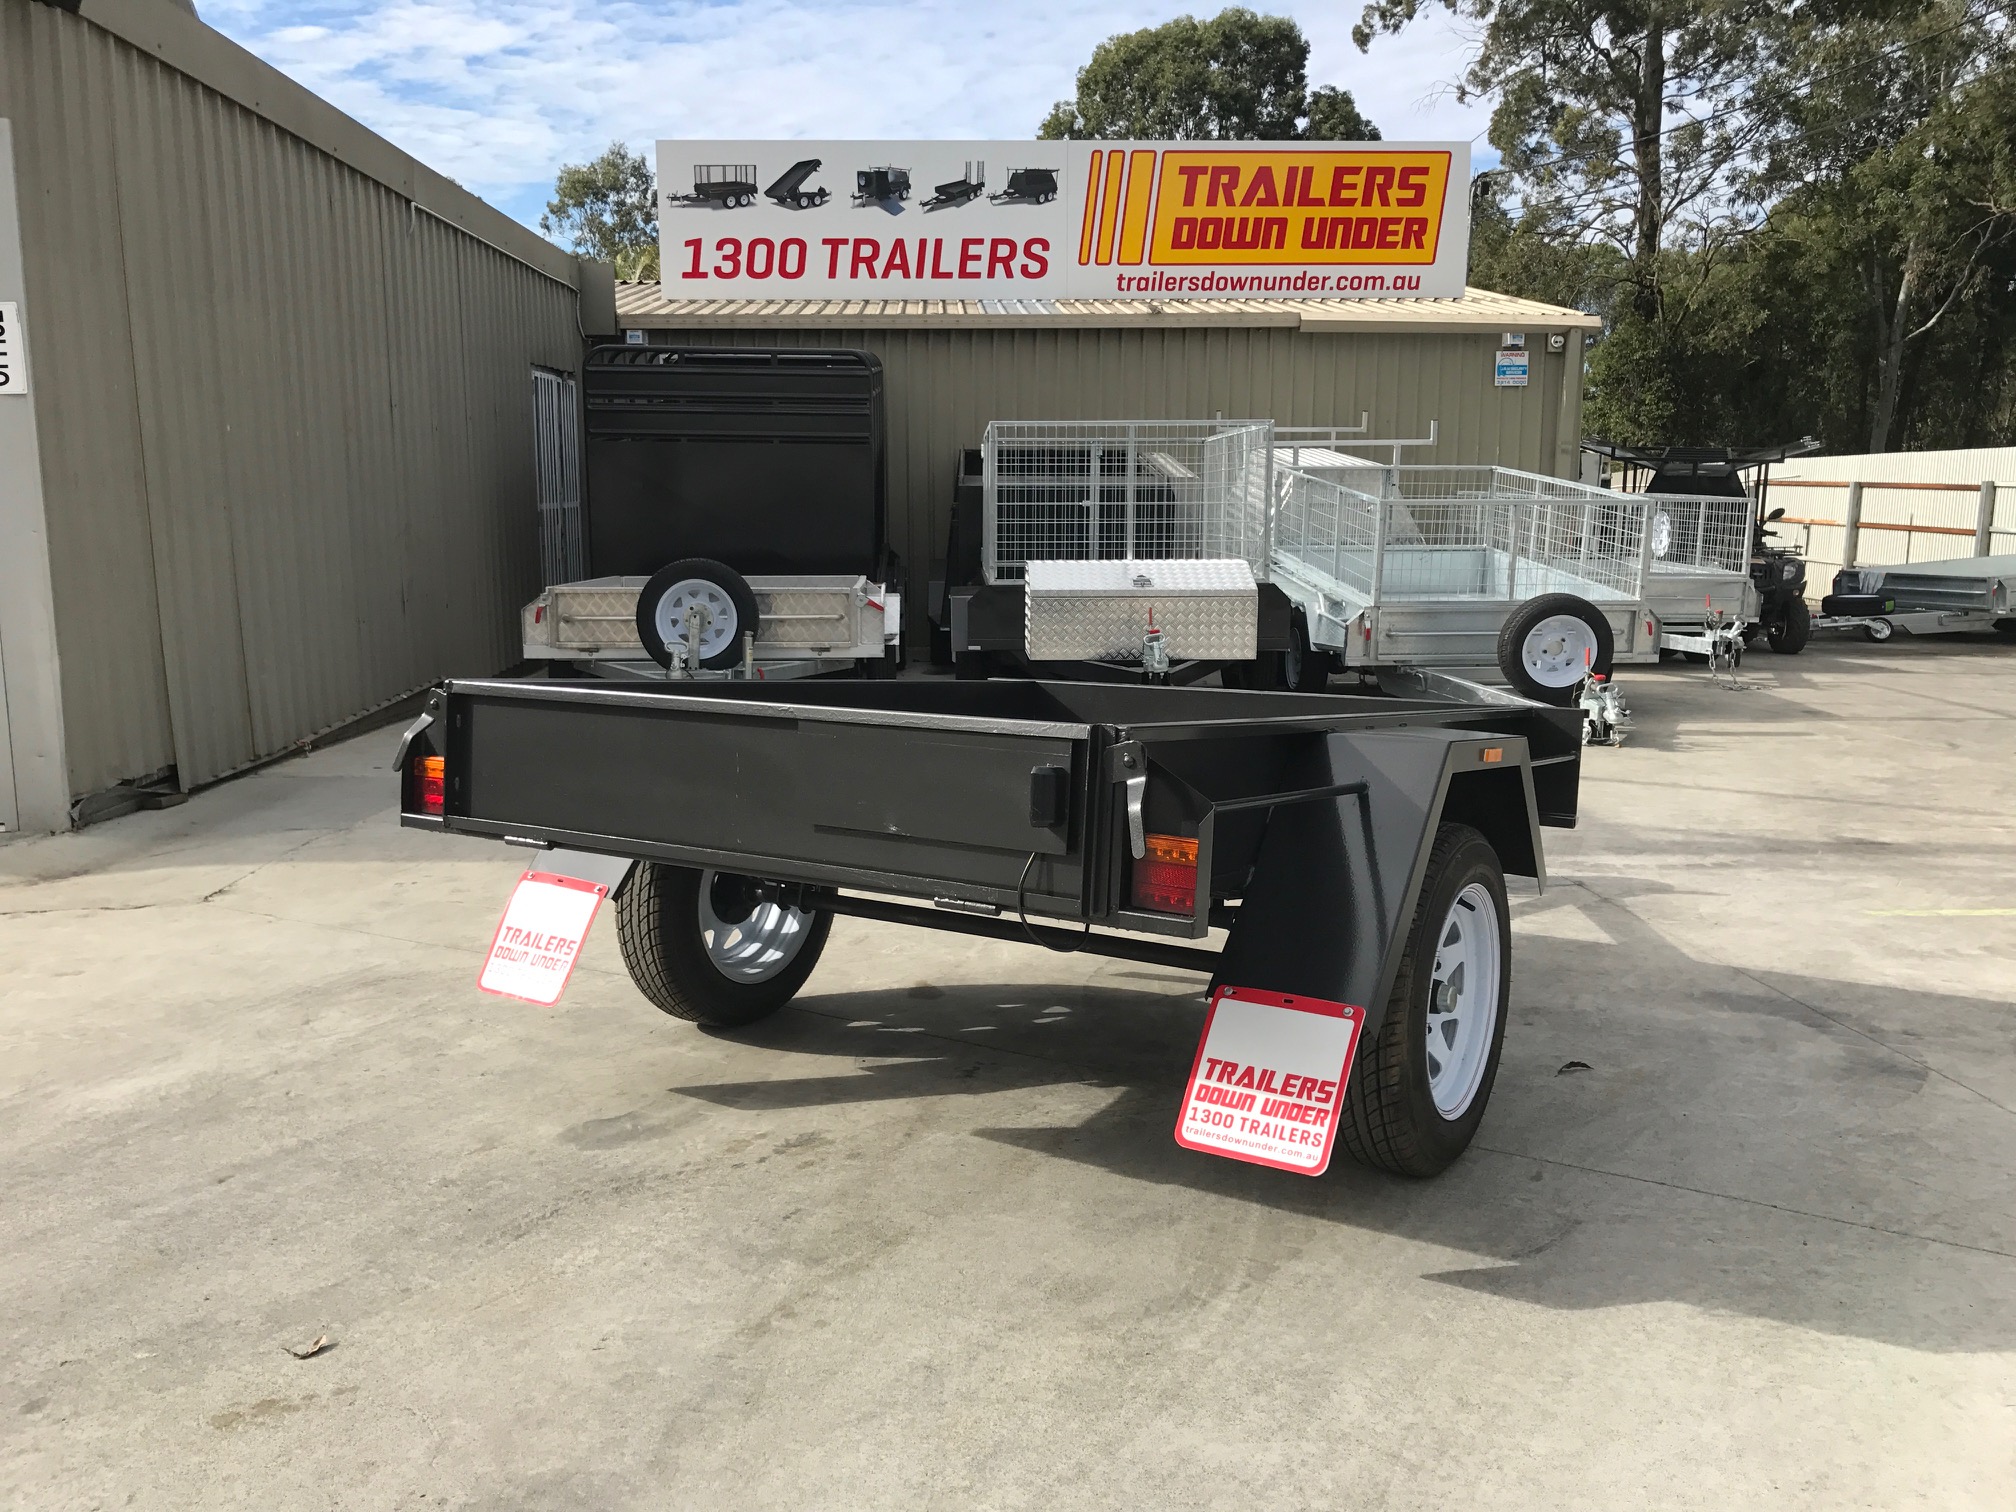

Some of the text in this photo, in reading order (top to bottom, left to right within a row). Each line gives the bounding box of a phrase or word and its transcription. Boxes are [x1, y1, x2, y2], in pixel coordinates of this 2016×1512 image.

[1178, 165, 1430, 208] TRAILERS
[1170, 217, 1429, 250] DOWN UNDER
[681, 237, 1051, 280] 1300 TRAILERS
[1116, 270, 1421, 292] trailersdownunder.com.au
[494, 945, 569, 972] DOWN UNDER
[502, 926, 577, 956] TRAILERS
[1204, 1057, 1337, 1104] TRAILERS
[1194, 1083, 1330, 1128] DOWN UNDER
[1185, 1125, 1318, 1161] trailersdownunder.com.au
[1188, 1106, 1323, 1148] 1300 TRAILERS
